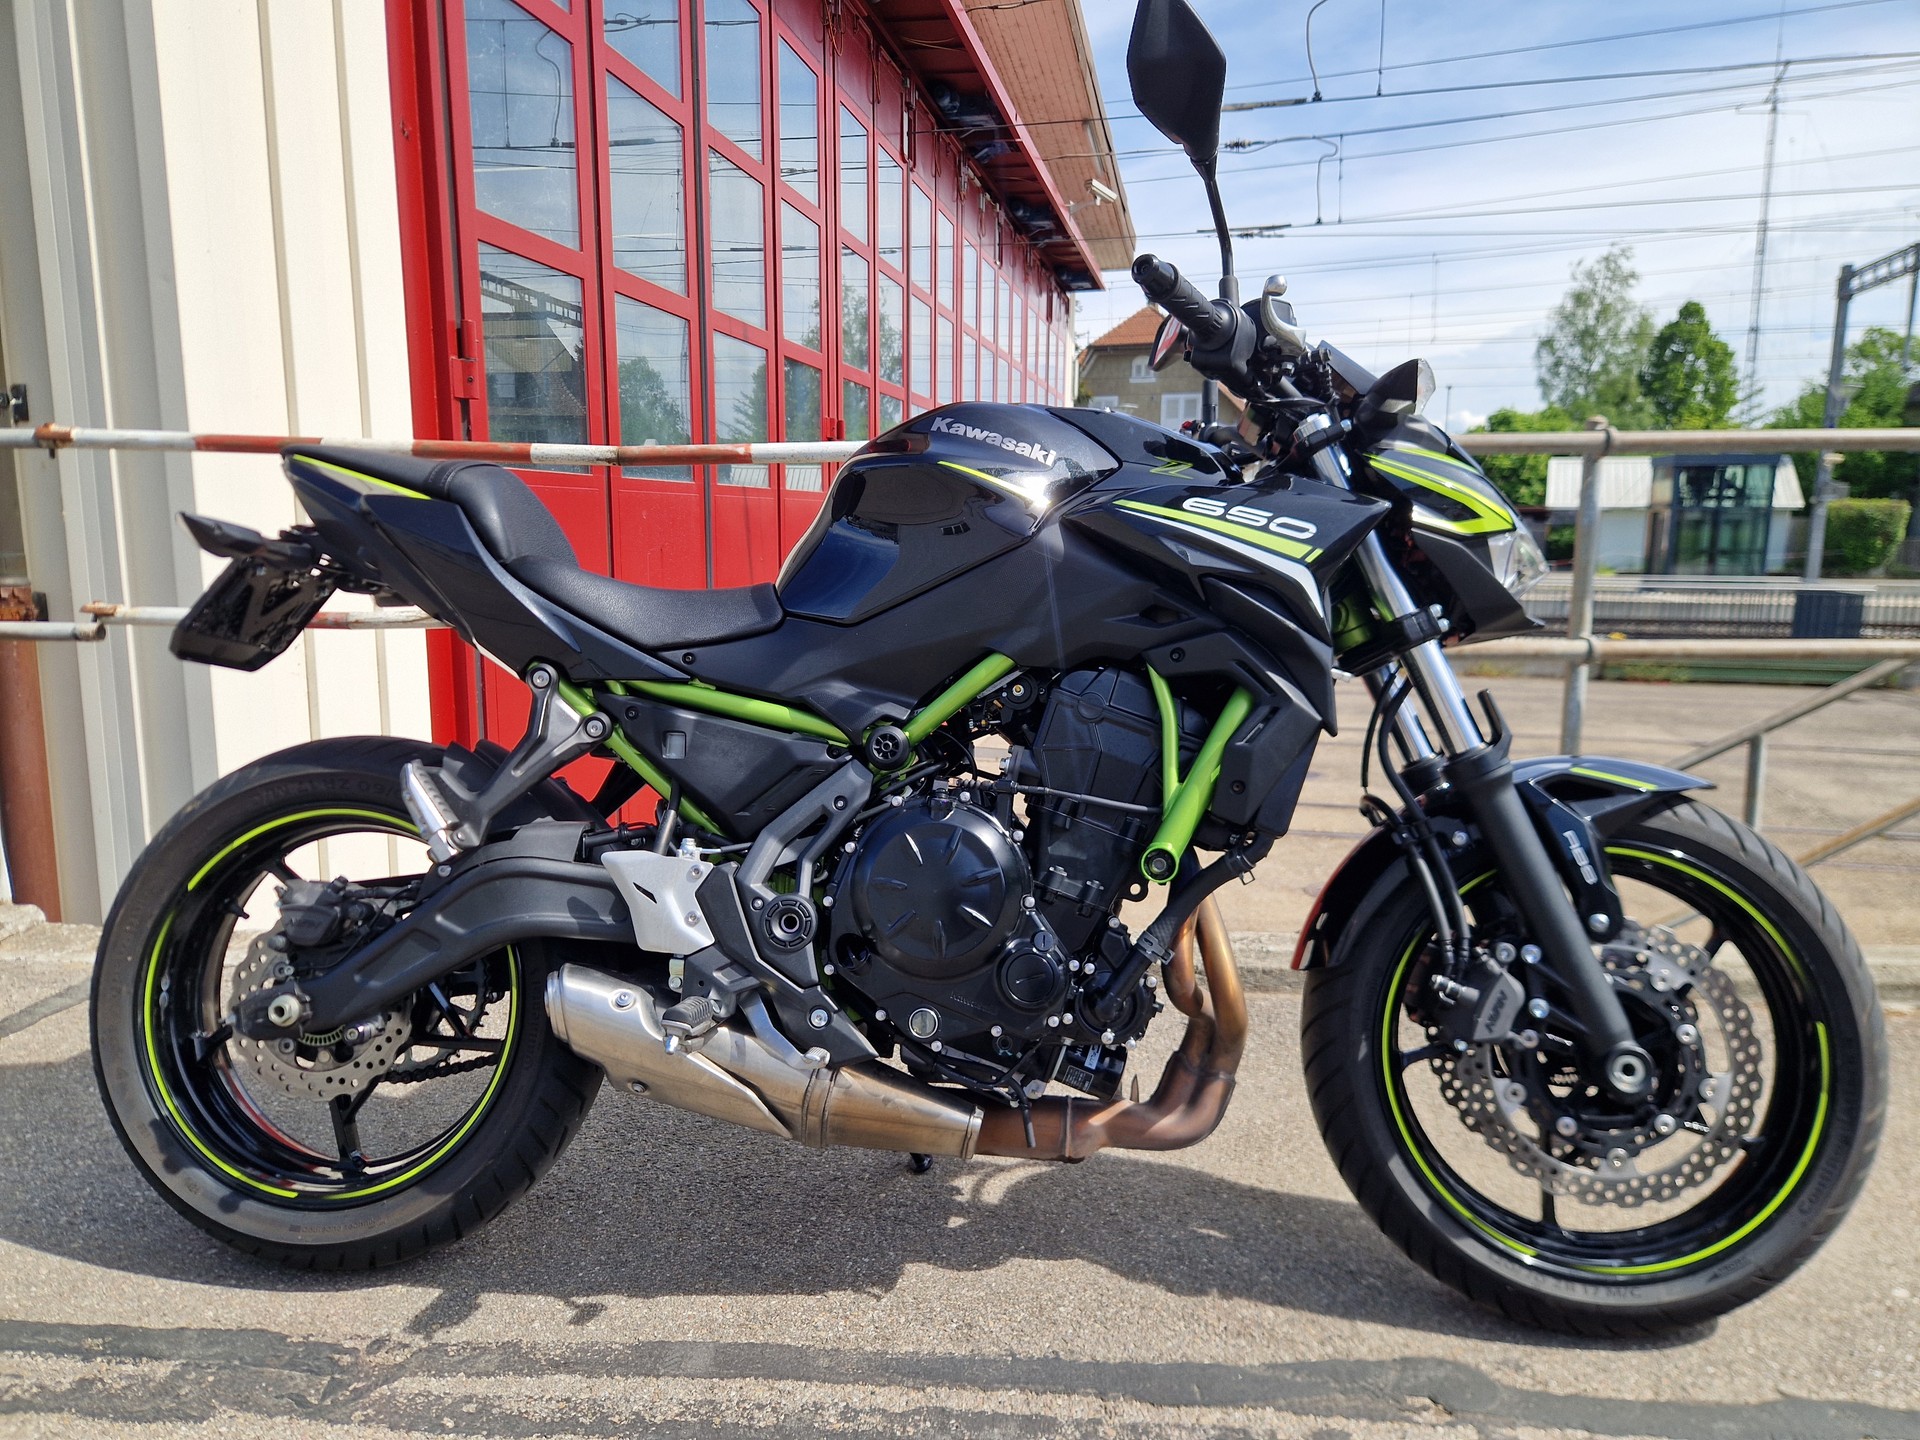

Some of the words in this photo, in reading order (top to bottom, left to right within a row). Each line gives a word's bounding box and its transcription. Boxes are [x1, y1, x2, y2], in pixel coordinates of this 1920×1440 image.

[930, 416, 1057, 466] Kawasaki
[1183, 497, 1317, 539] 650
[1562, 829, 1598, 885] ABS
